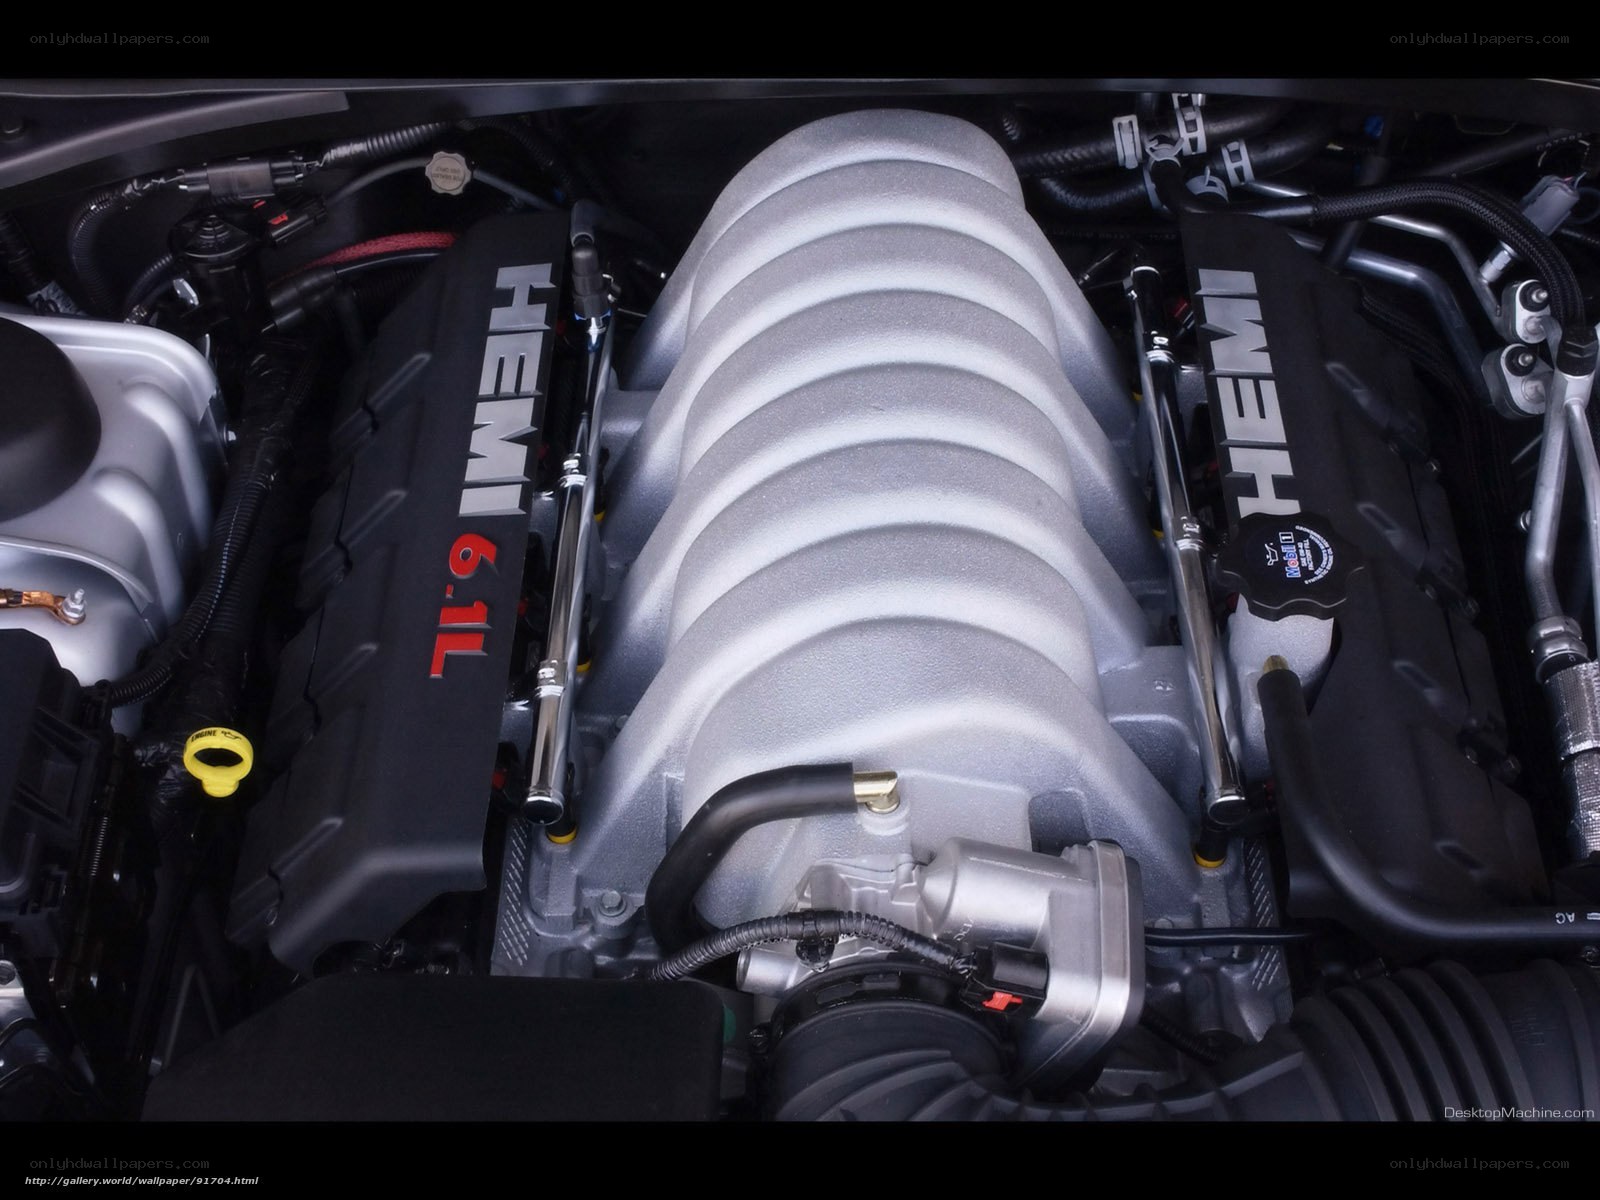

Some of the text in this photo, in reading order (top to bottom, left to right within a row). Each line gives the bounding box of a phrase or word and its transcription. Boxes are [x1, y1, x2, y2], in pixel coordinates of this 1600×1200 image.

[1196, 268, 1302, 518] HEMI
[429, 263, 557, 679] HEMI 6.1L
[1281, 545, 1301, 578] Mobil
[191, 730, 217, 743] ENGINE
[1555, 912, 1575, 924] AC
